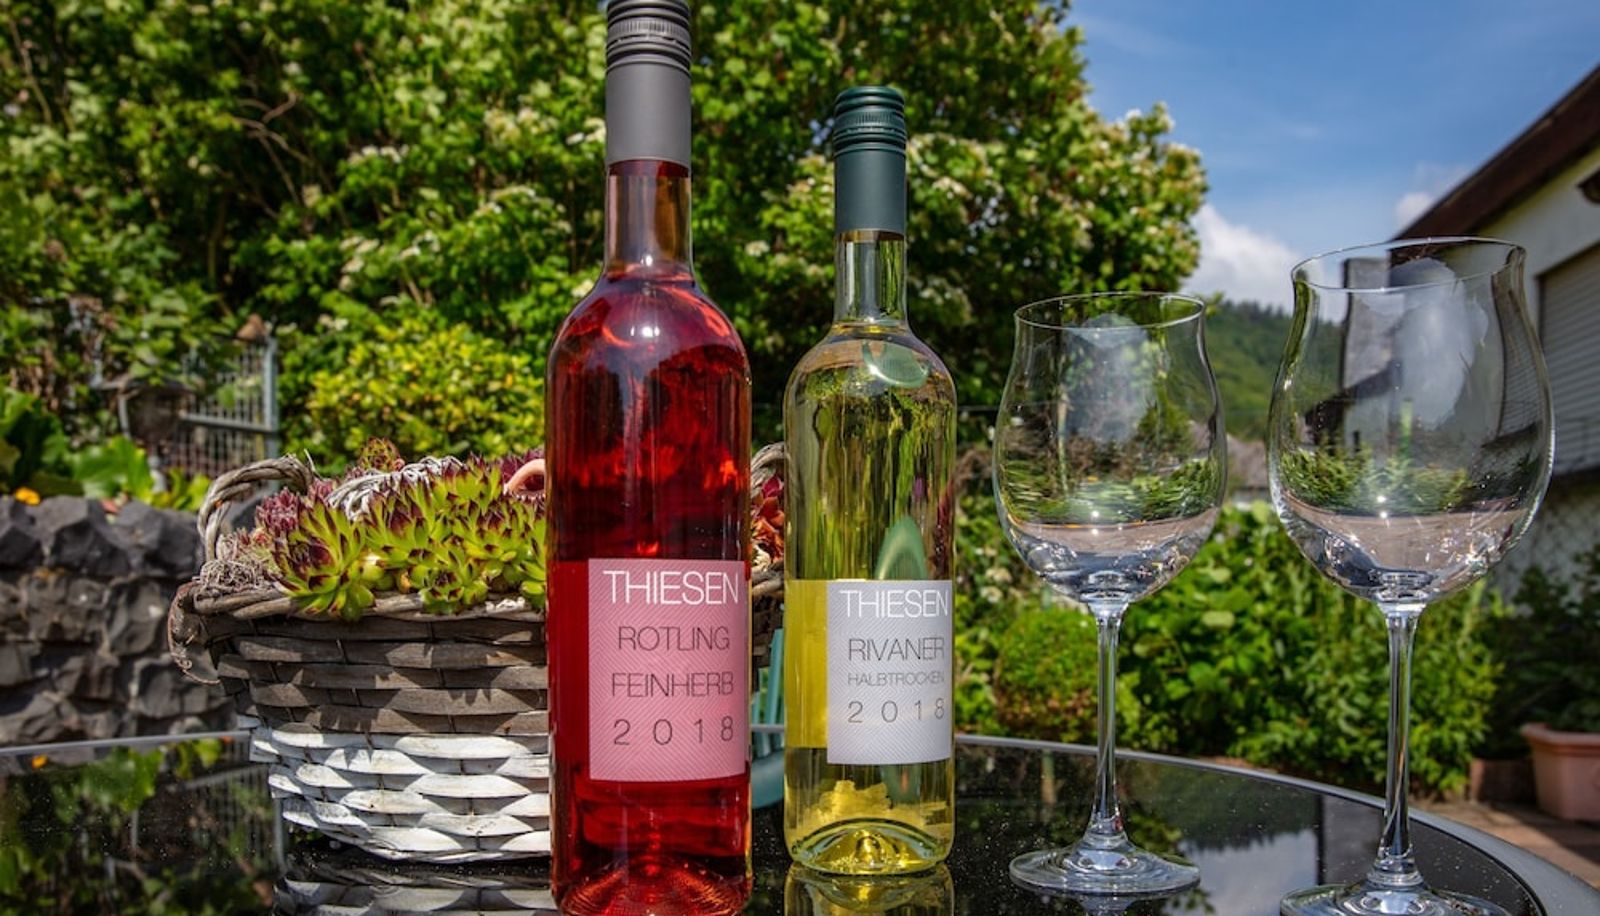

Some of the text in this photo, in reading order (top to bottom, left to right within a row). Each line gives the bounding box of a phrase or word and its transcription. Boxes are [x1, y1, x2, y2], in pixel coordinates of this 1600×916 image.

[603, 570, 738, 605] THIESEN
[839, 589, 948, 618] THIESEN
[618, 626, 730, 651] ROTLING
[848, 637, 945, 661] RIVANER
[612, 671, 734, 697] FEINHERB
[847, 671, 945, 686] HALBTROCKEN
